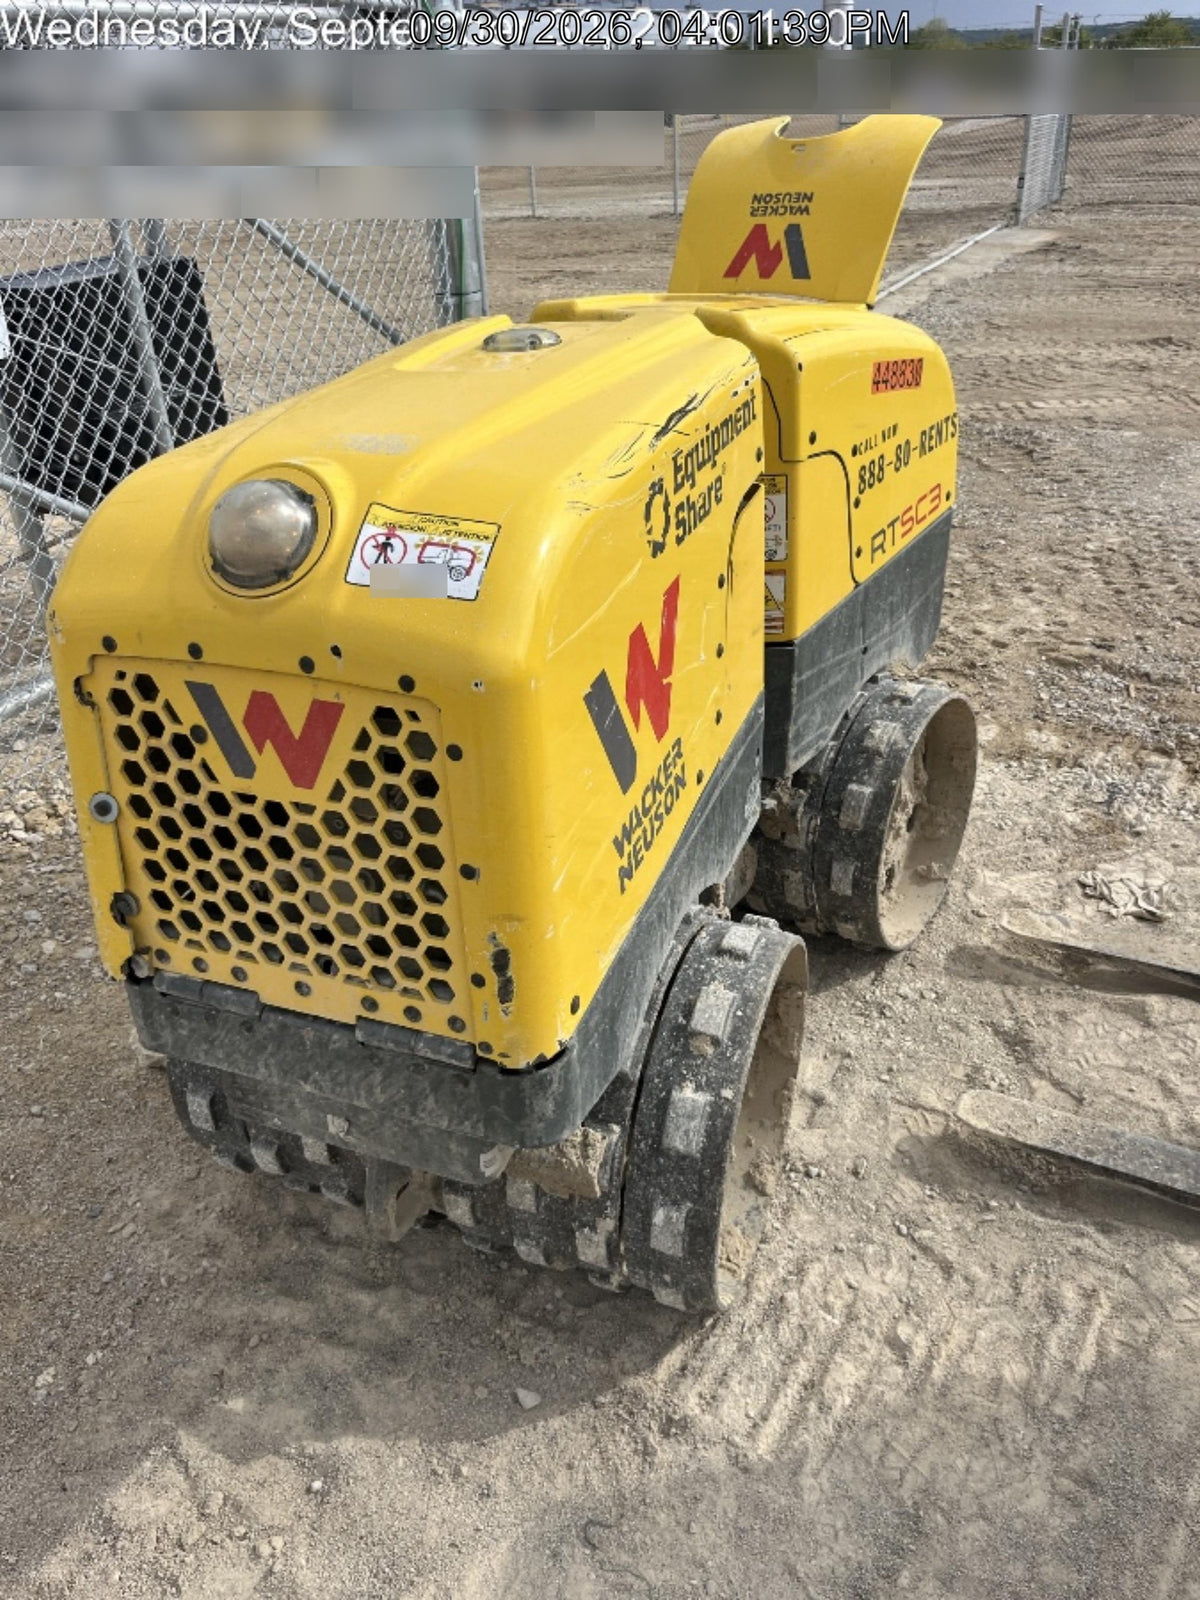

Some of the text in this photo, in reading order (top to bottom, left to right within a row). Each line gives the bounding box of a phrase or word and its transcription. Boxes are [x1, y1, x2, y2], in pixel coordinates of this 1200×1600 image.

[750, 205, 811, 217] WACKER
[751, 192, 814, 205] NEUSON
[672, 388, 757, 495] Equipment
[858, 423, 899, 455] CALL NOW
[858, 412, 958, 495] 888-80-RENTS
[675, 476, 722, 546] Share
[870, 483, 942, 564] RTSC3
[612, 736, 683, 859] WACKER
[617, 762, 688, 895] NEUSON
